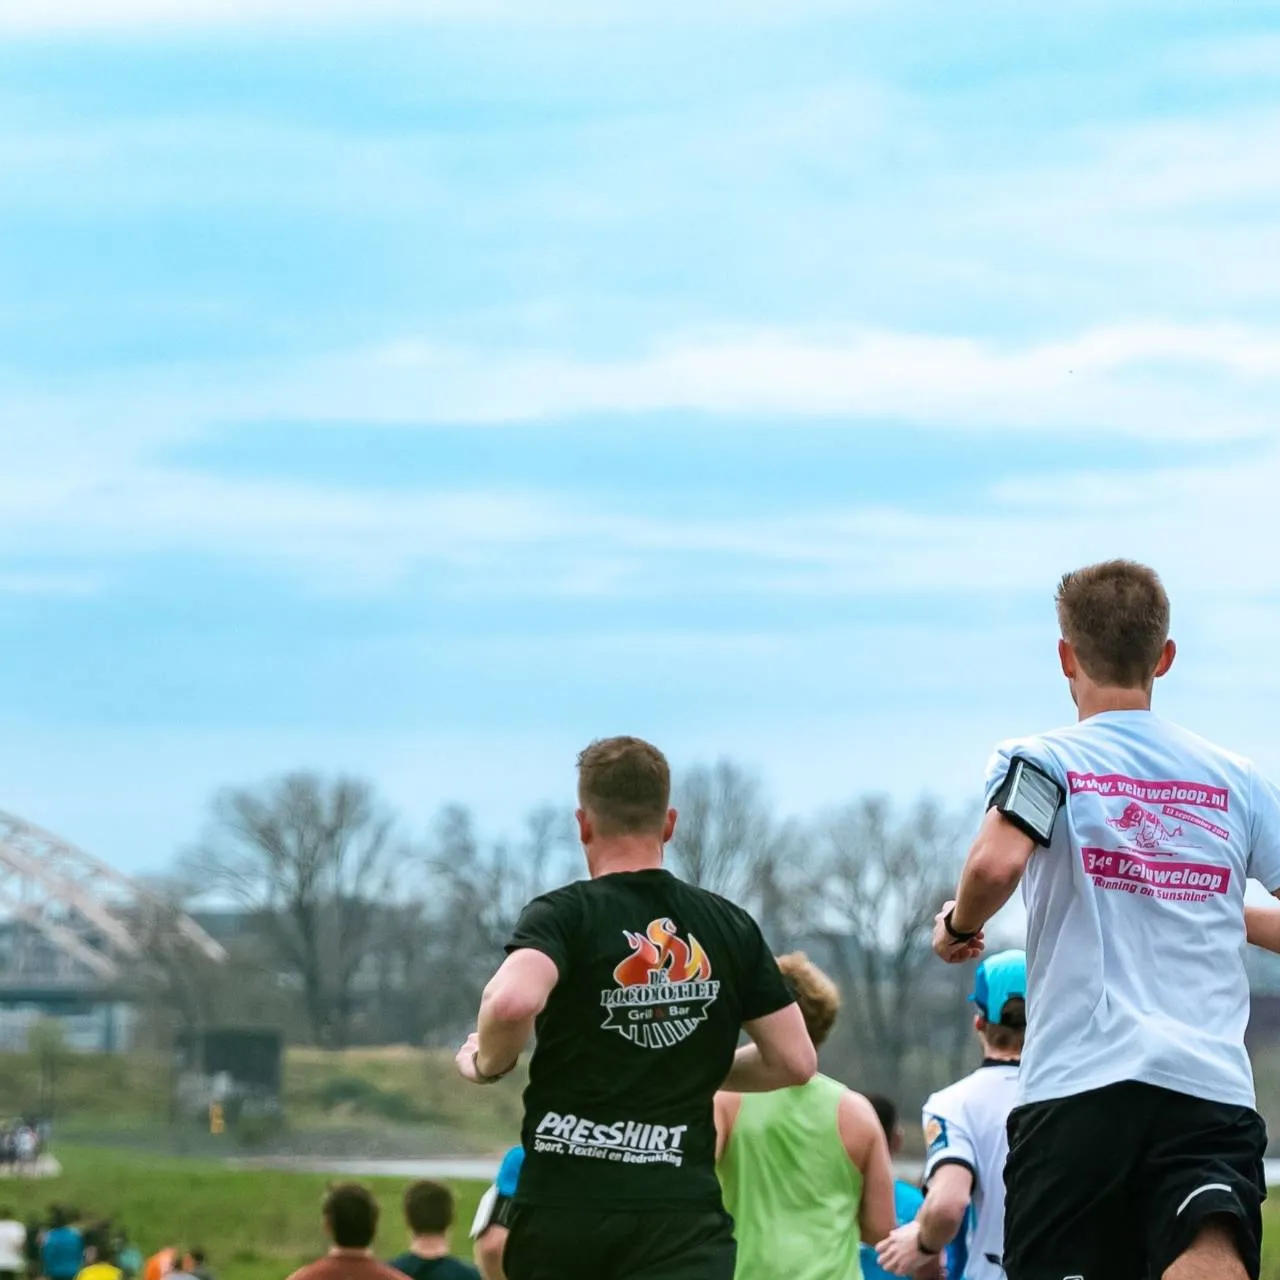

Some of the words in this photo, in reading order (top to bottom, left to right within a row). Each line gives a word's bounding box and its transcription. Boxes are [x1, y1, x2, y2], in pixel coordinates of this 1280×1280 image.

[1071, 777, 1225, 807] www.veluweloop.nl
[1118, 858, 1222, 890] Veluweloop
[1140, 887, 1155, 897] on
[649, 968, 669, 984] DE
[628, 1009, 653, 1021] Grill
[669, 1005, 691, 1016] Bar
[535, 1111, 688, 1150] PRESSHIRT
[534, 1139, 564, 1154] Sport,
[568, 1143, 606, 1159] Textiel
[608, 1150, 622, 1161] en
[622, 1151, 683, 1168] Bedrukking
